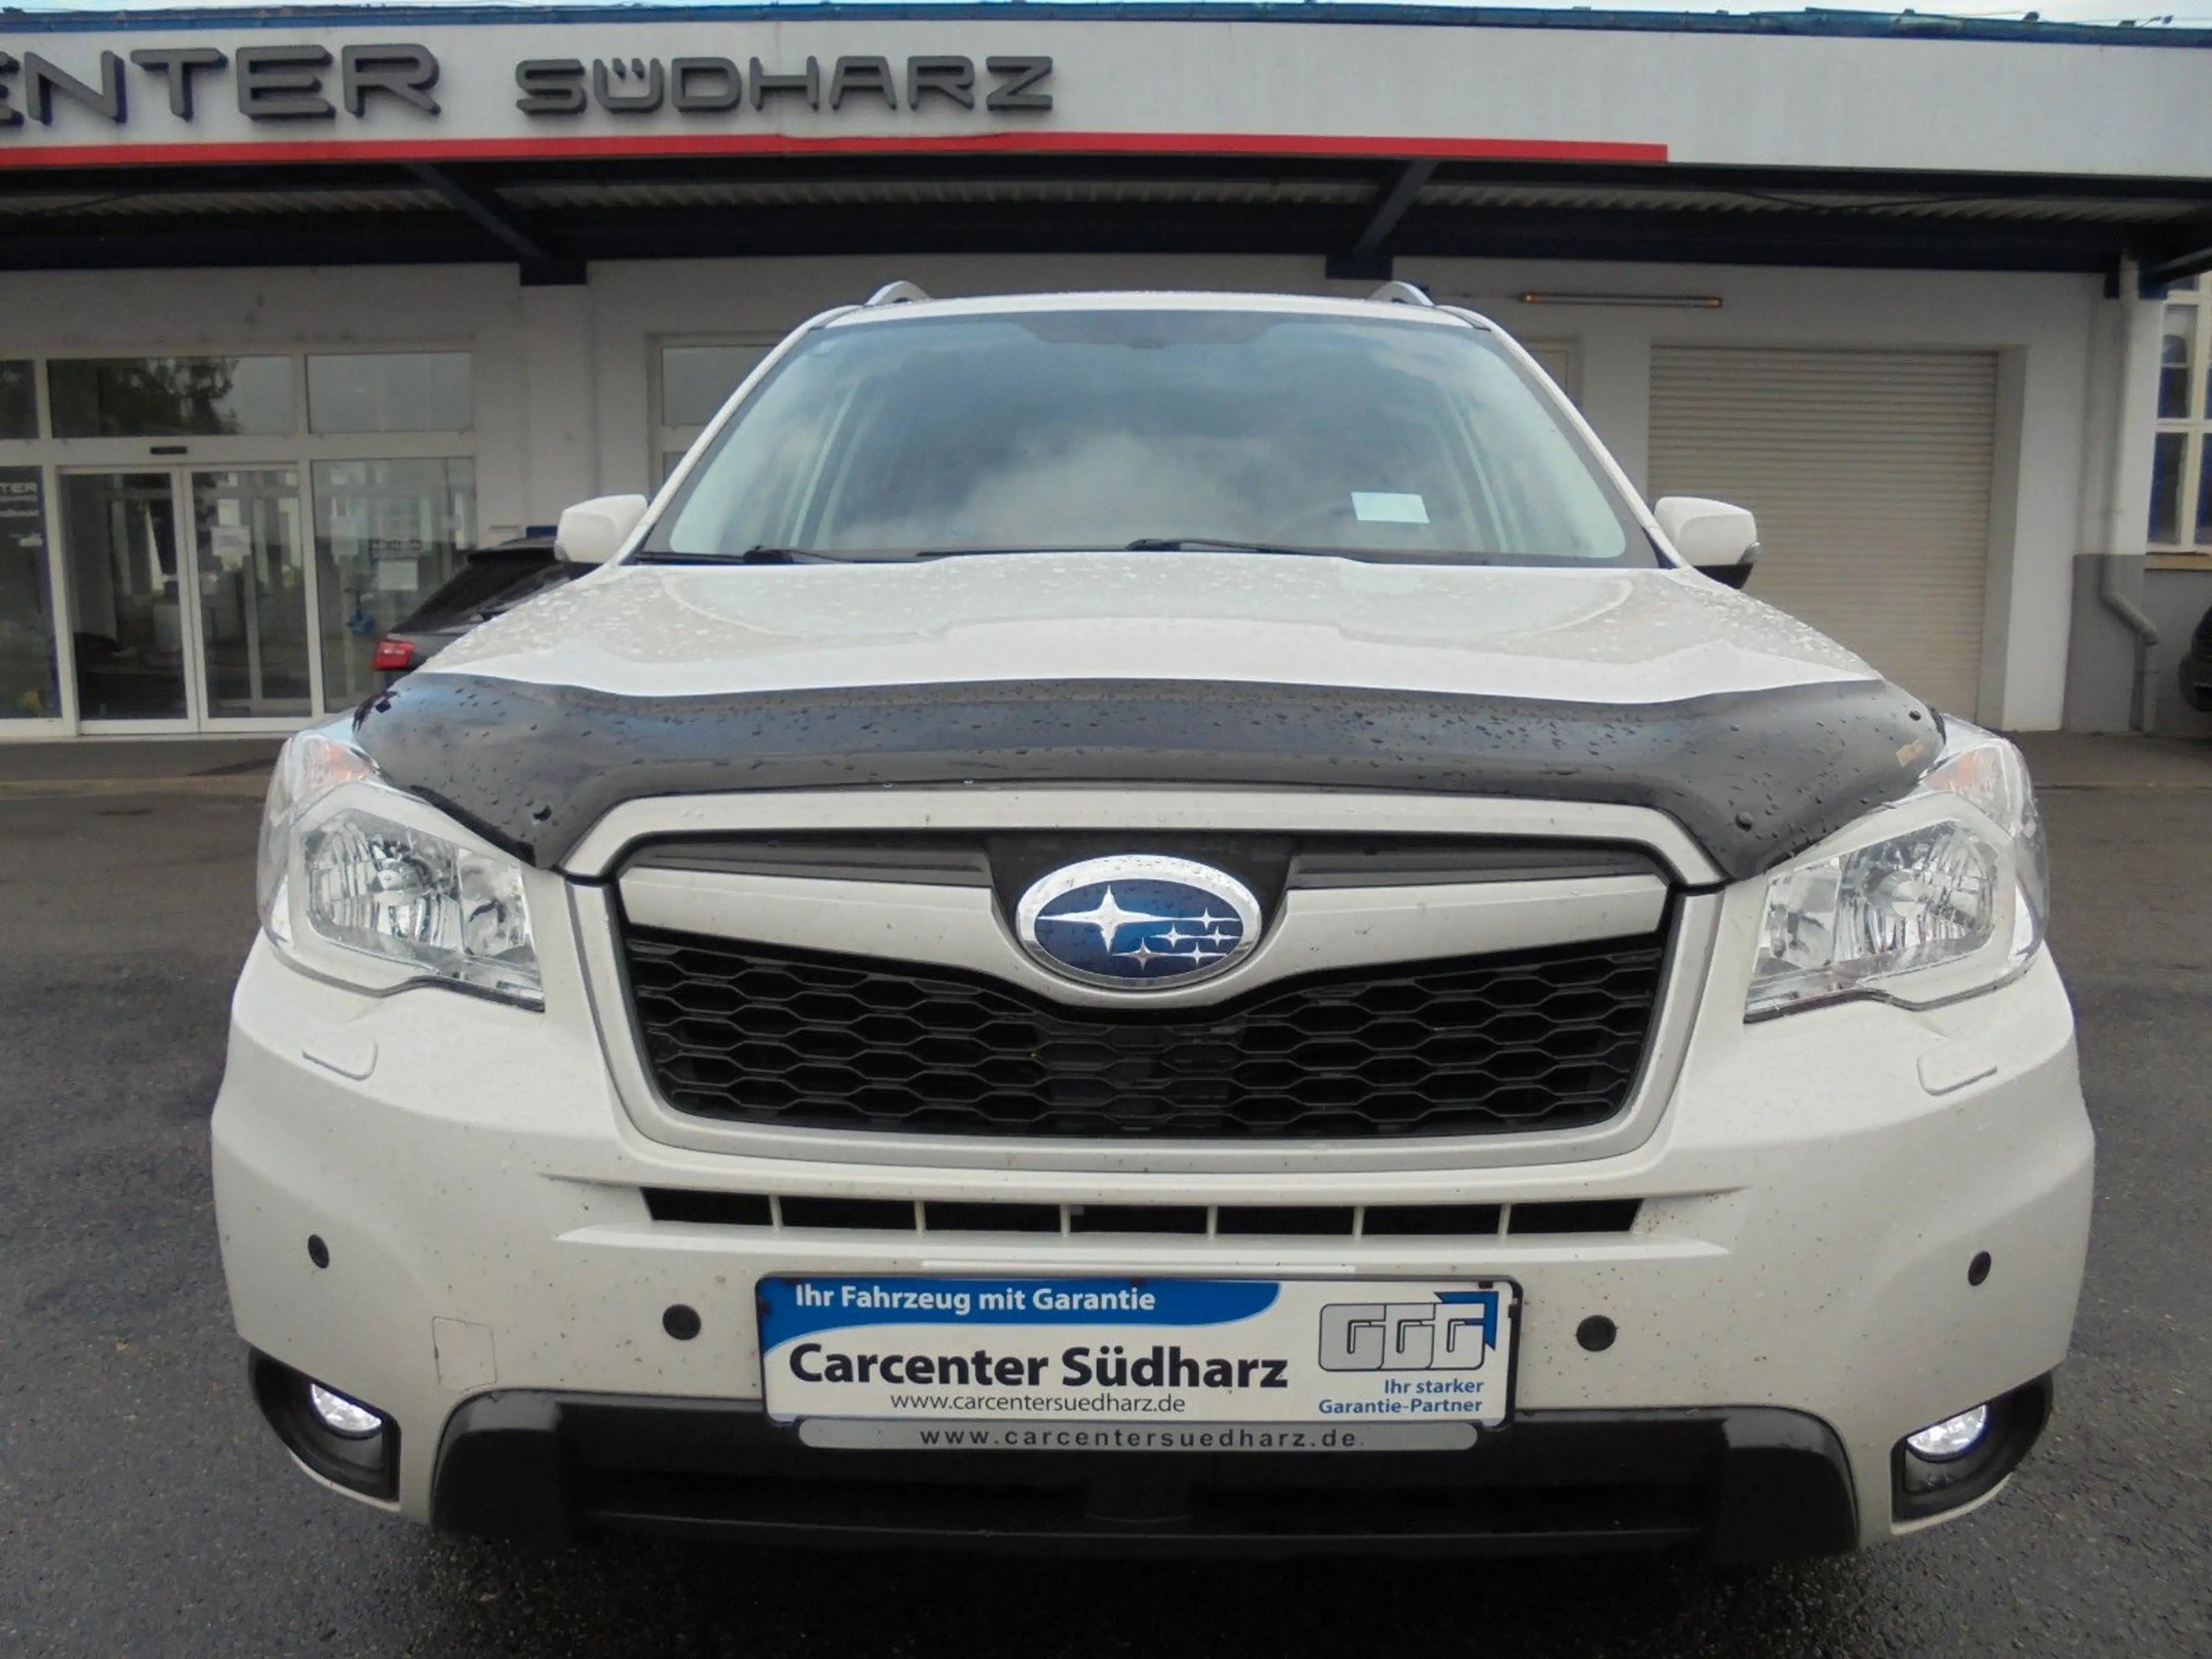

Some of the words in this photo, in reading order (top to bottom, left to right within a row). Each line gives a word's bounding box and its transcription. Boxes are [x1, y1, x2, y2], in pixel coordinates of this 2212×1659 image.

[0, 44, 440, 128] NTER
[516, 55, 1053, 115] SÜDHARZ
[796, 1285, 835, 1307] Ihr
[842, 1286, 970, 1316] Fahrzeug
[979, 1287, 1025, 1310] mit
[1033, 1287, 1156, 1311] Garantie
[789, 1343, 1048, 1385] Carcenter
[1062, 1345, 1288, 1388] Südharz
[1384, 1378, 1411, 1394] Ihr
[1415, 1378, 1484, 1393] starker
[890, 1394, 1185, 1412] www.carcentersuedharz.de
[1319, 1398, 1483, 1414] Garantie-Partner
[921, 1429, 1355, 1447] www.carcentersuedharz.de
